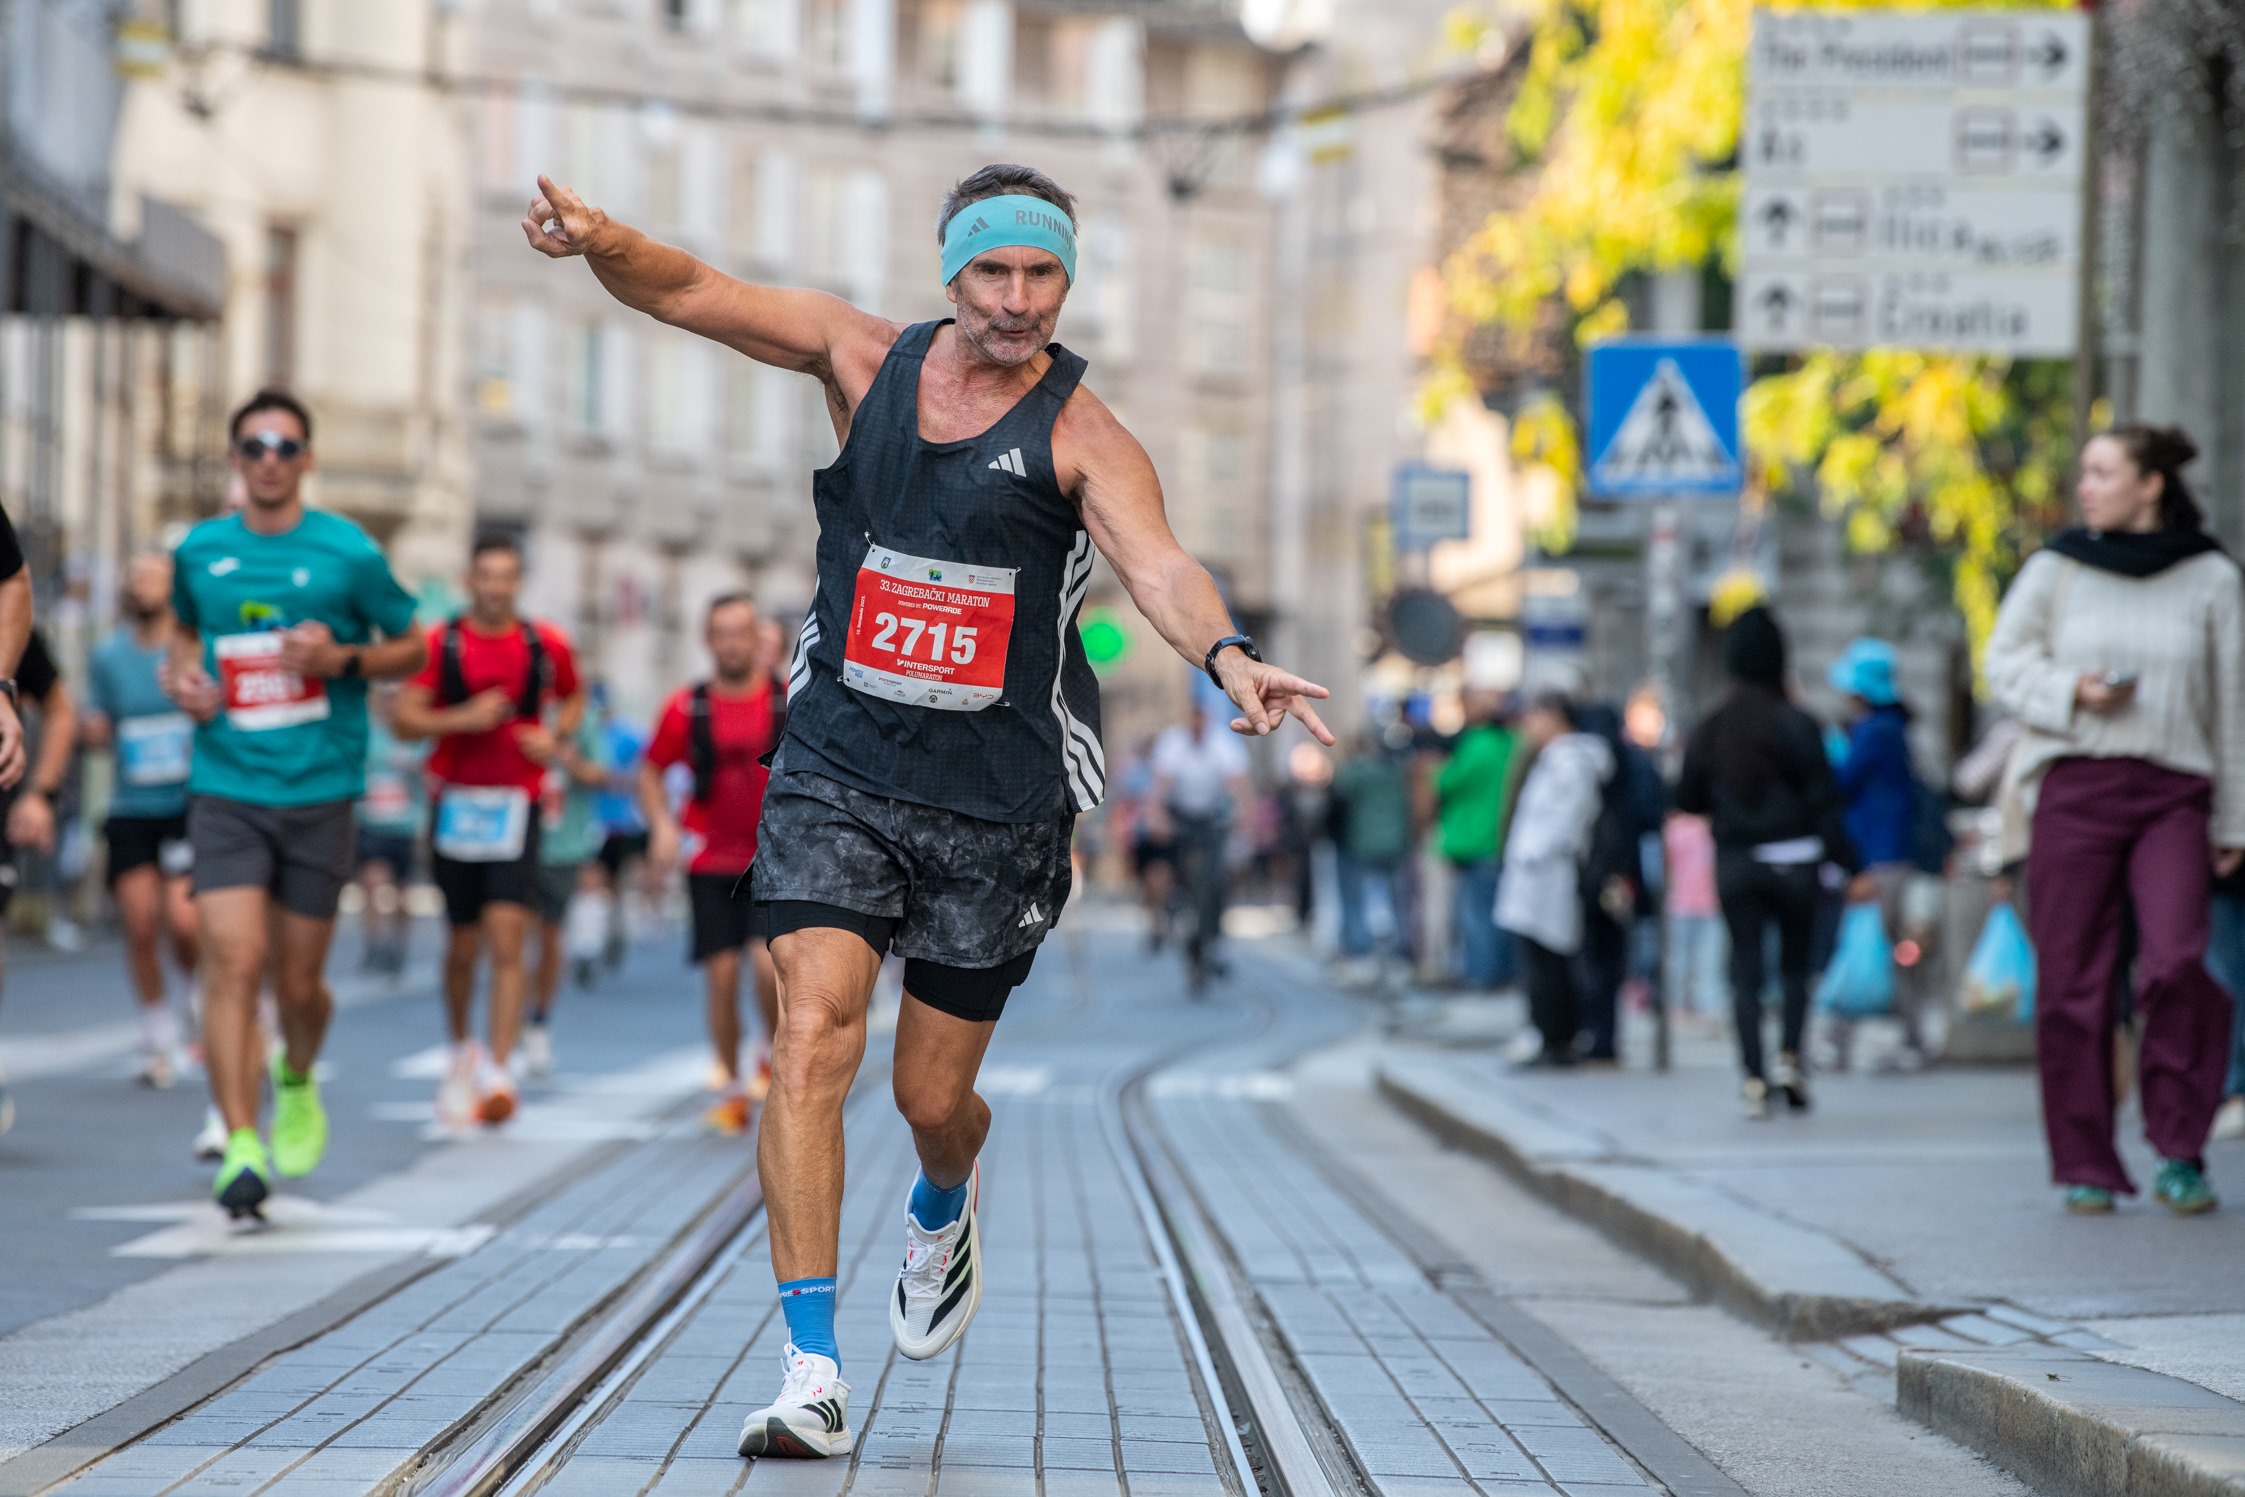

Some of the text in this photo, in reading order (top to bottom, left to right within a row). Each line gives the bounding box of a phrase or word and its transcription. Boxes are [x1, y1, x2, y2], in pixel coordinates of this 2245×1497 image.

[1820, 42, 1952, 73] President
[1015, 210, 1072, 250] RUNNING
[1879, 213, 1971, 250] Ilica
[1879, 299, 2028, 338] Croatia
[922, 603, 962, 615] POWERADE
[946, 592, 990, 608] MARATON
[871, 612, 978, 665] 2715
[904, 660, 955, 675] INTERSPORT
[905, 669, 943, 682] POLUMARATON
[928, 688, 953, 696] GARMIN
